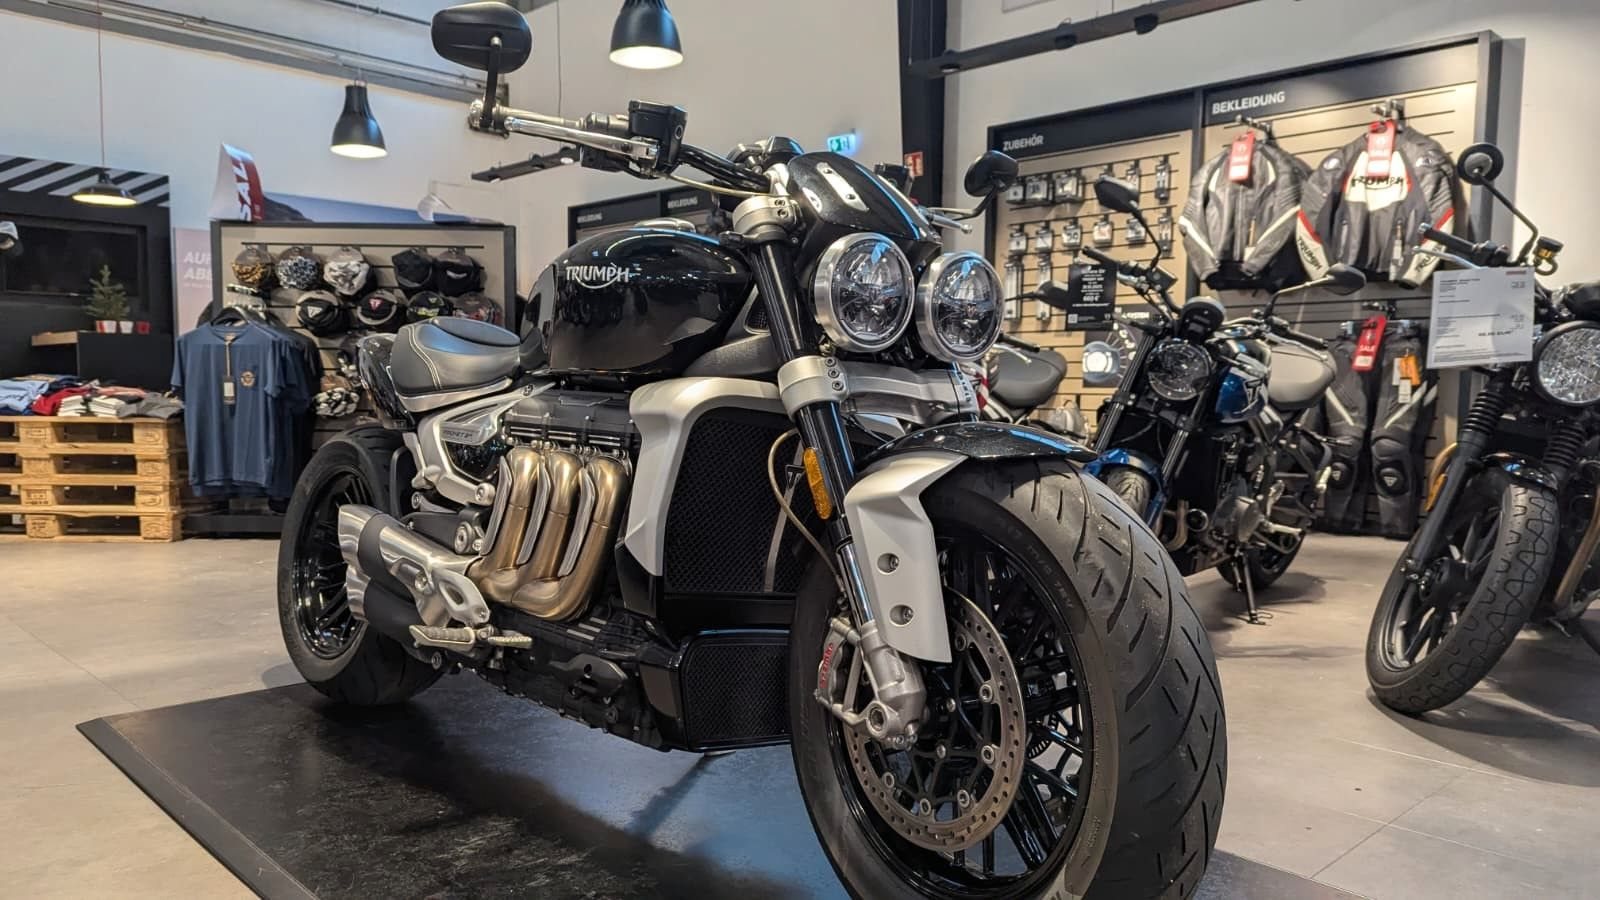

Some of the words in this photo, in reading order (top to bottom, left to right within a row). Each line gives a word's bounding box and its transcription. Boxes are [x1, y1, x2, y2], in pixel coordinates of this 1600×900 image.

[1212, 91, 1286, 115] BEKLEIDUNG
[1003, 133, 1044, 151] ZUBEHÖR
[565, 263, 630, 287] TRIUMPH
